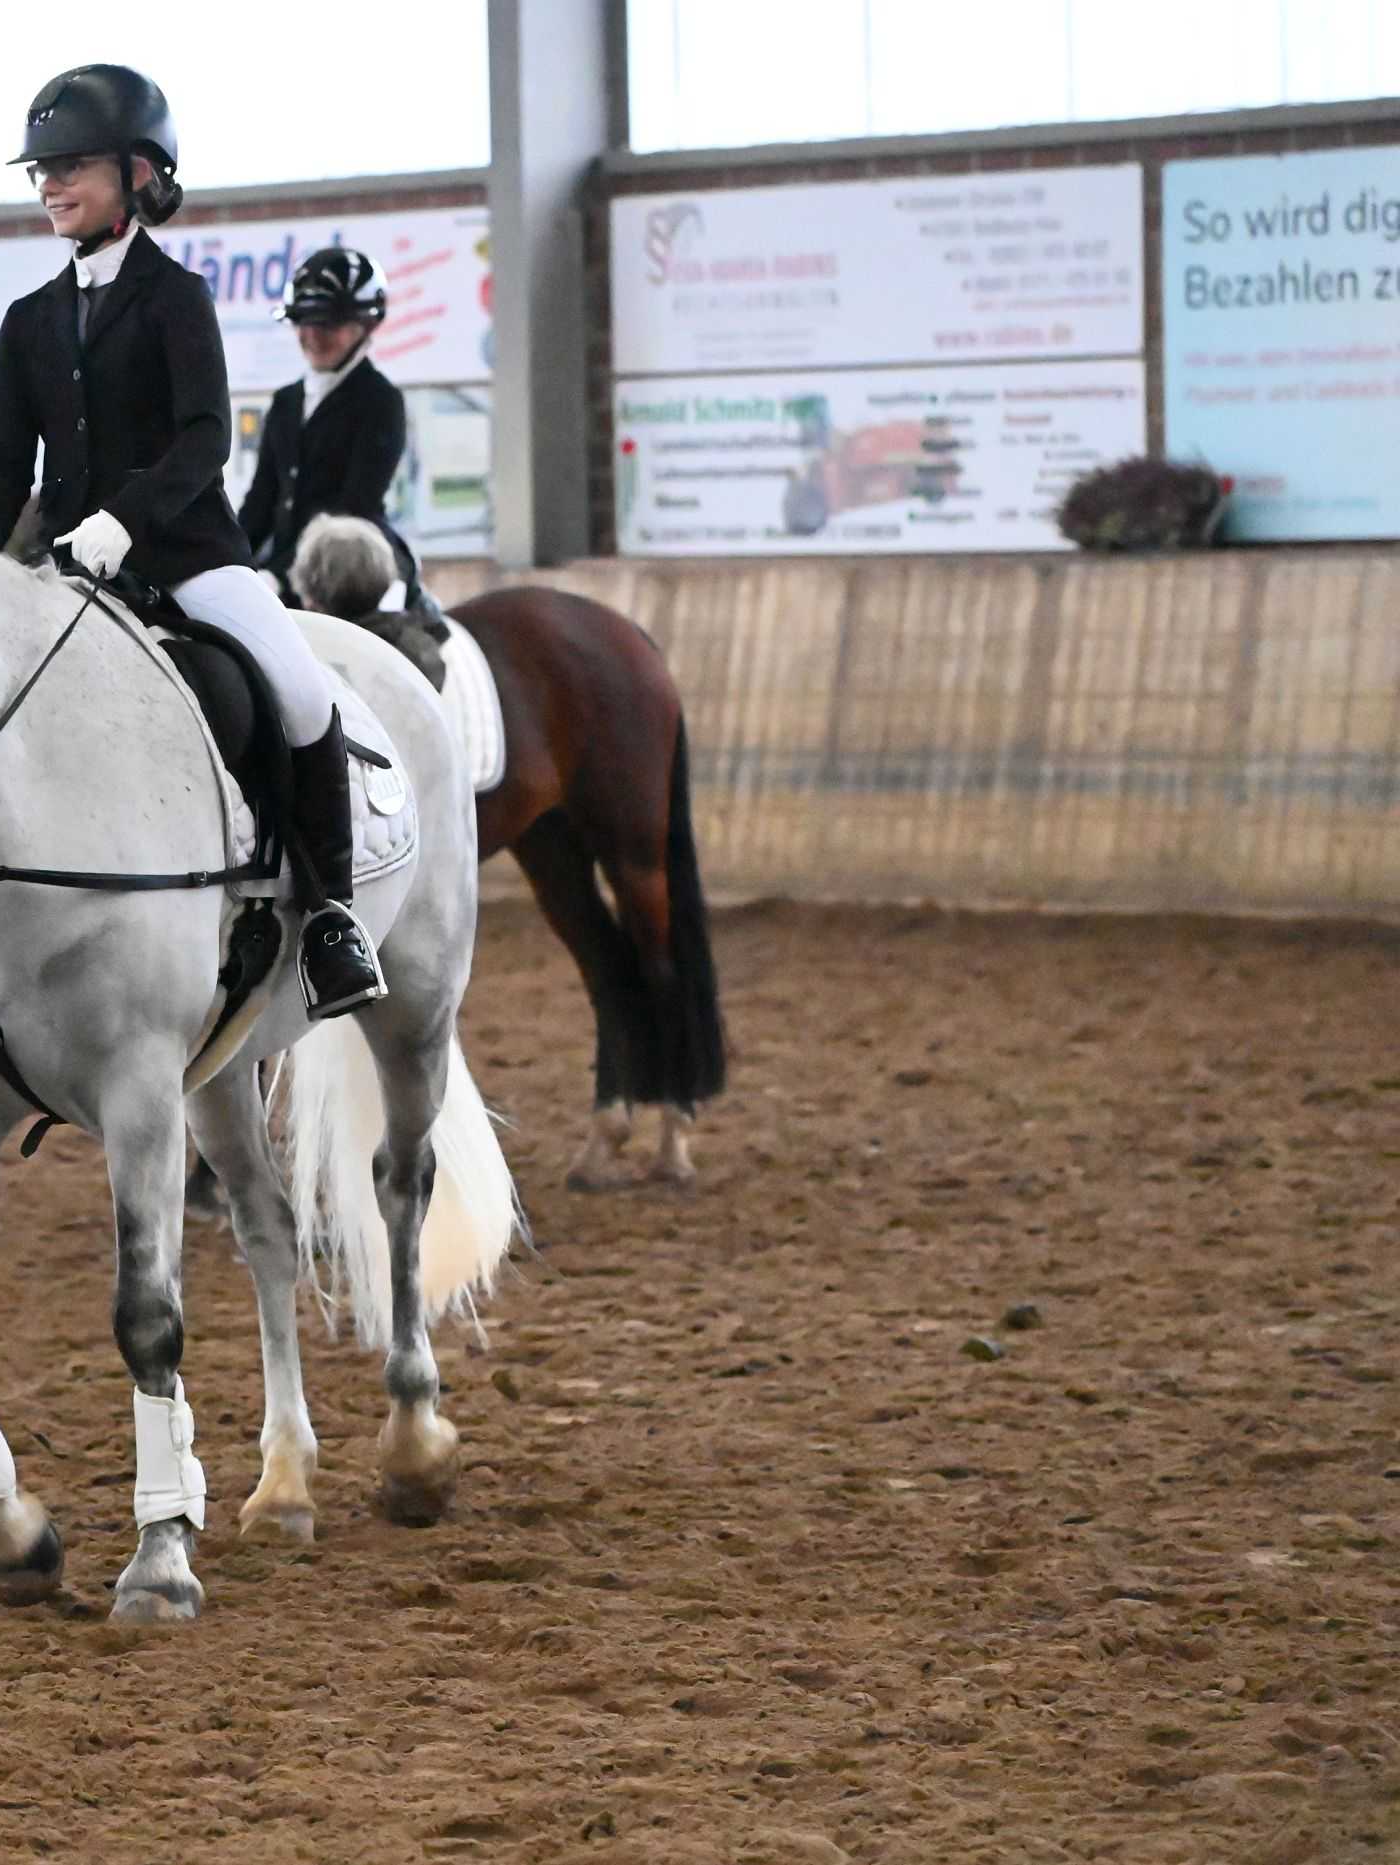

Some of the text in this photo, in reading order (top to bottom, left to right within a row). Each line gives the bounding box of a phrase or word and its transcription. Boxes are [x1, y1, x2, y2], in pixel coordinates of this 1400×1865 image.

[1183, 198, 1232, 244] So
[1242, 189, 1330, 238] wird
[1183, 256, 1360, 311] Bezahlen
